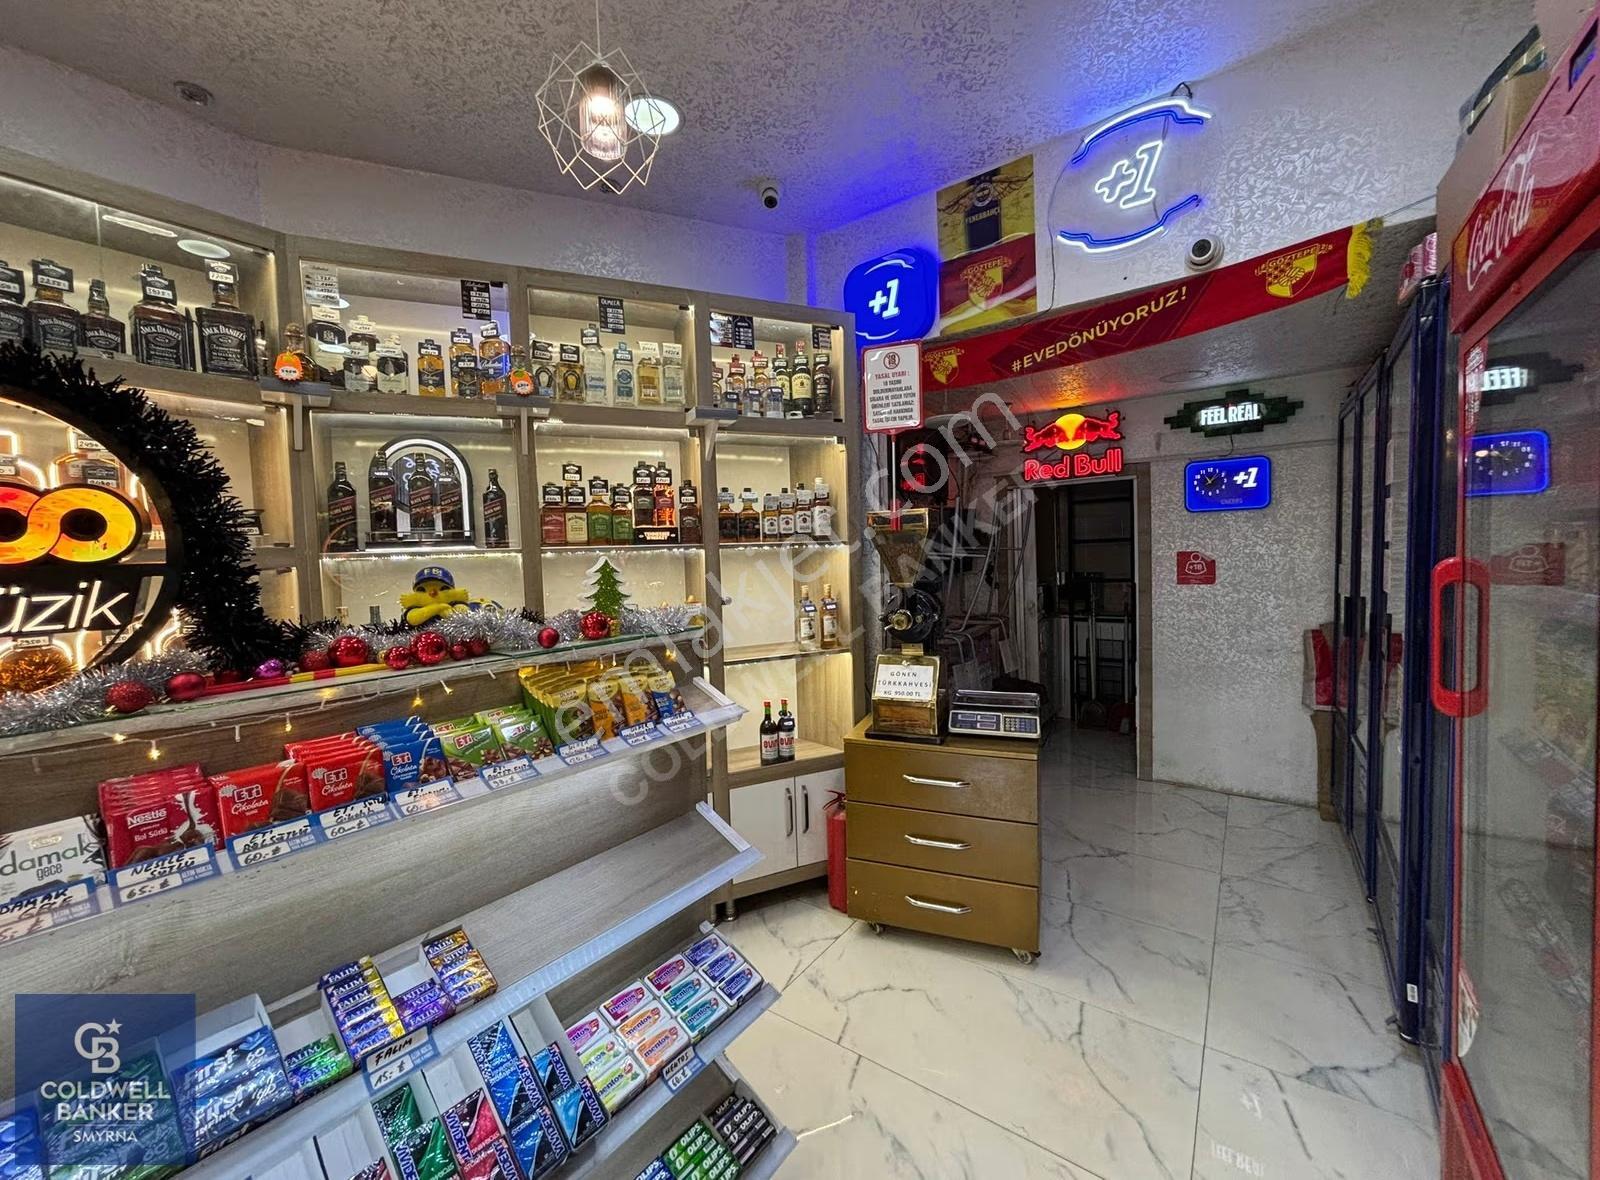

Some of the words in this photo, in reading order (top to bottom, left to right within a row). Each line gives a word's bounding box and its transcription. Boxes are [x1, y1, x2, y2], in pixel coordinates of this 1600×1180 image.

[868, 278, 900, 319] +1
[1011, 286, 1187, 372] #EVEDÖNÜYORUZ!
[1200, 406, 1228, 426] FEEL
[1228, 403, 1262, 423] REAL
[1024, 457, 1070, 482] Red
[1074, 447, 1123, 476] Bull
[1233, 467, 1259, 488] +1
[890, 670, 918, 678] GÖNEN
[134, 833, 147, 842] Bol
[148, 828, 168, 838] Sütlü
[0, 833, 100, 876] damak
[36, 863, 63, 880] gece
[0, 888, 69, 915] DAMAK
[328, 965, 359, 983] FALIM
[332, 977, 364, 996] FALIM
[669, 985, 694, 1005] mentos
[610, 994, 637, 1014] mentos
[687, 1004, 711, 1025] mentos
[627, 1015, 652, 1037] mentos
[375, 1038, 413, 1066] FALIM
[643, 1035, 670, 1059] mentos
[517, 1061, 542, 1109] VIVIDENT
[580, 1076, 606, 1128] VIVIDENT
[445, 1110, 473, 1162] VIVIDENT
[538, 1107, 565, 1159] VIVIDENT
[680, 1122, 702, 1146] OLIPS
[687, 1131, 710, 1155] OLIPS
[703, 1145, 725, 1169] OLIPS
[709, 1154, 731, 1179] OLIPS
